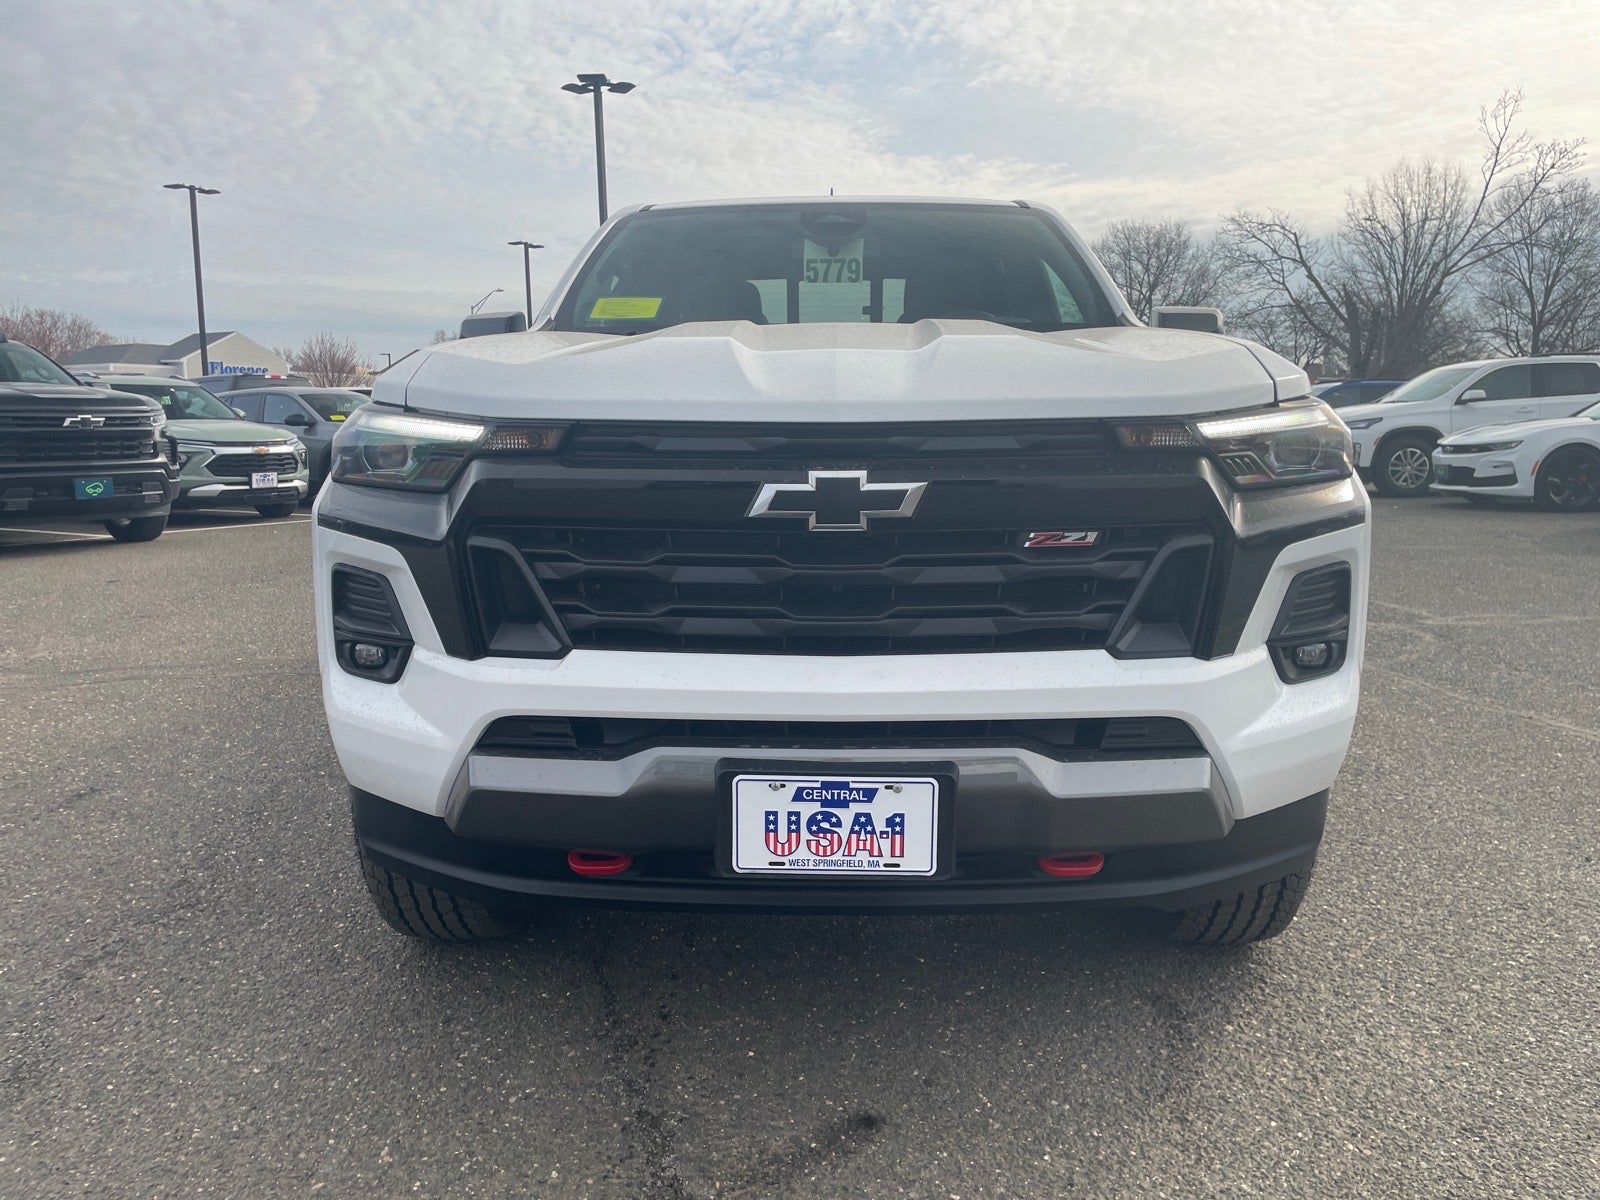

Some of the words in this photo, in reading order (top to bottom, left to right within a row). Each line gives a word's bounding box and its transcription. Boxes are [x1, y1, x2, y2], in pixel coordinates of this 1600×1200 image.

[806, 258, 861, 283] 5779
[208, 360, 269, 375] Florence
[802, 789, 868, 801] CENTRAL
[788, 858, 811, 868] WEST
[812, 859, 866, 869] SPRINGFIELD,
[867, 859, 881, 869] MA
